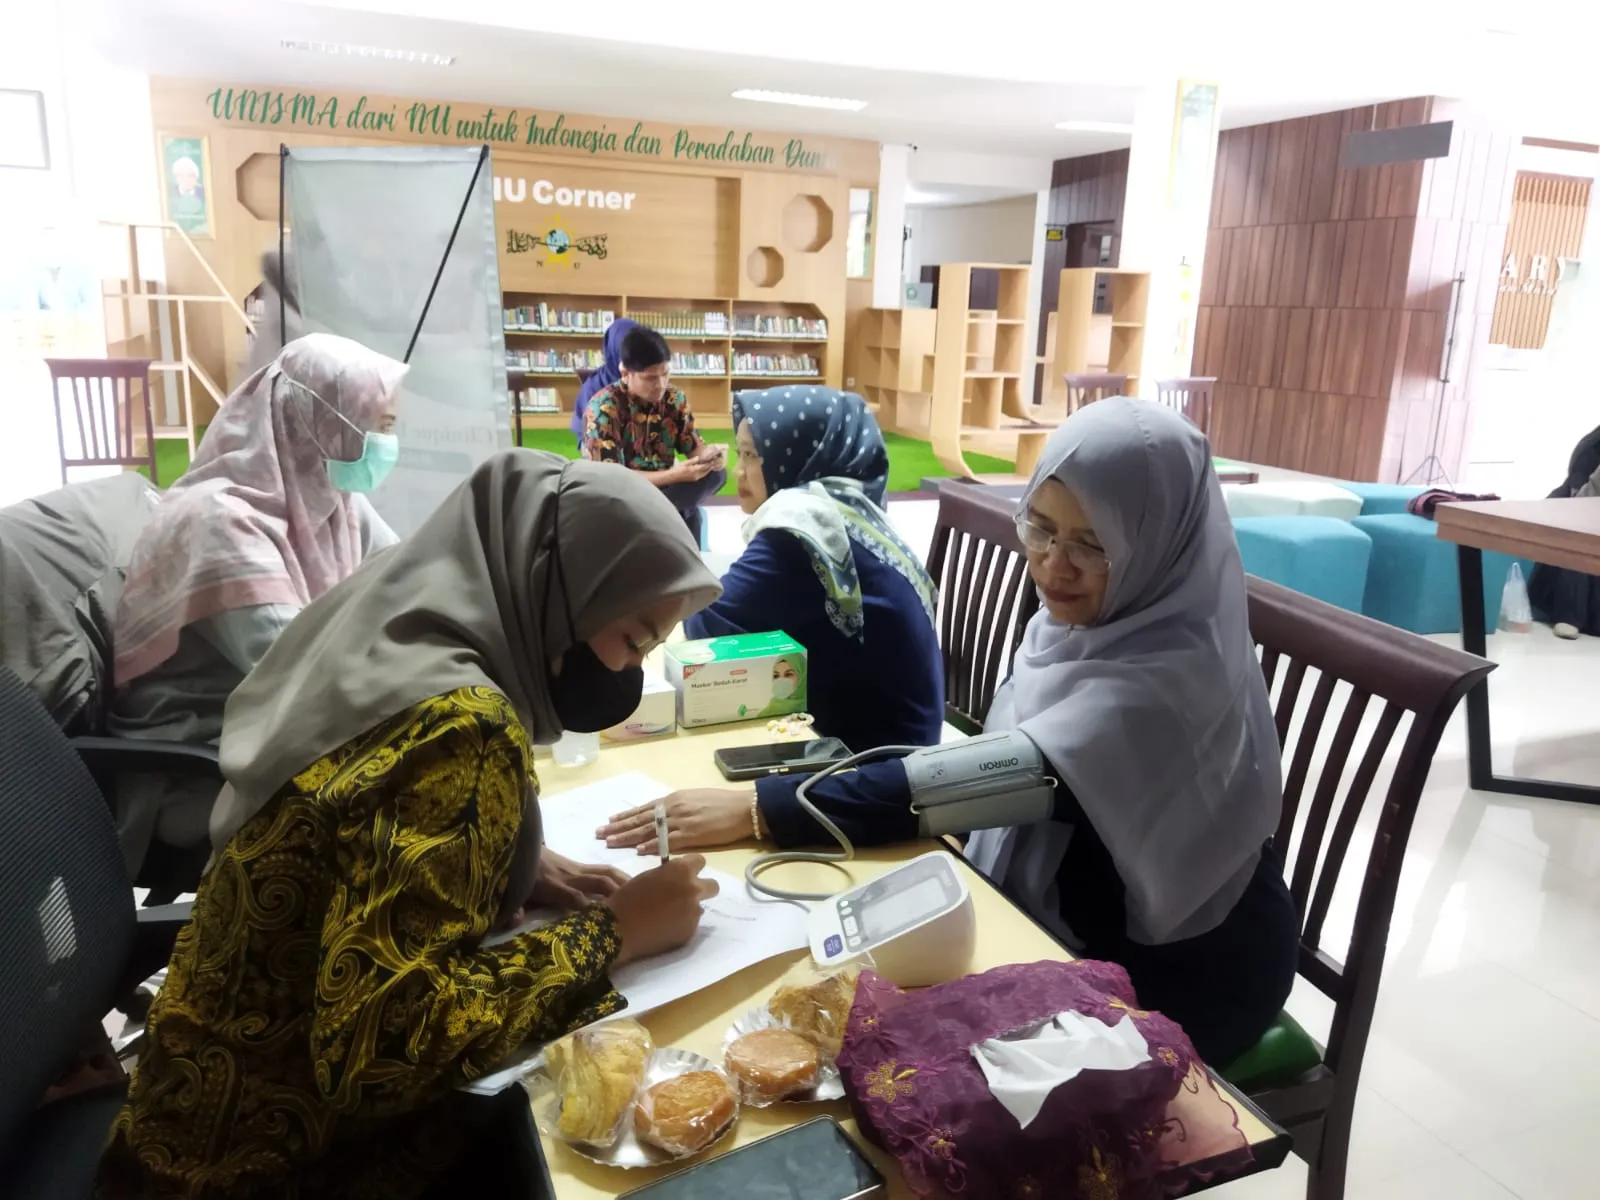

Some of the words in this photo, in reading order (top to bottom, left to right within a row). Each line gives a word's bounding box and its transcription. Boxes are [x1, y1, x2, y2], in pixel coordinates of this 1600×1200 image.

[207, 87, 339, 129] UNISMA
[346, 95, 398, 132] dari
[403, 102, 452, 136] NU
[456, 107, 520, 143] untuk
[525, 114, 617, 153] Indonesia
[623, 121, 662, 155] dan
[673, 129, 775, 164] Peradaban
[532, 179, 636, 210] Corner
[979, 757, 1018, 771] OMRON
